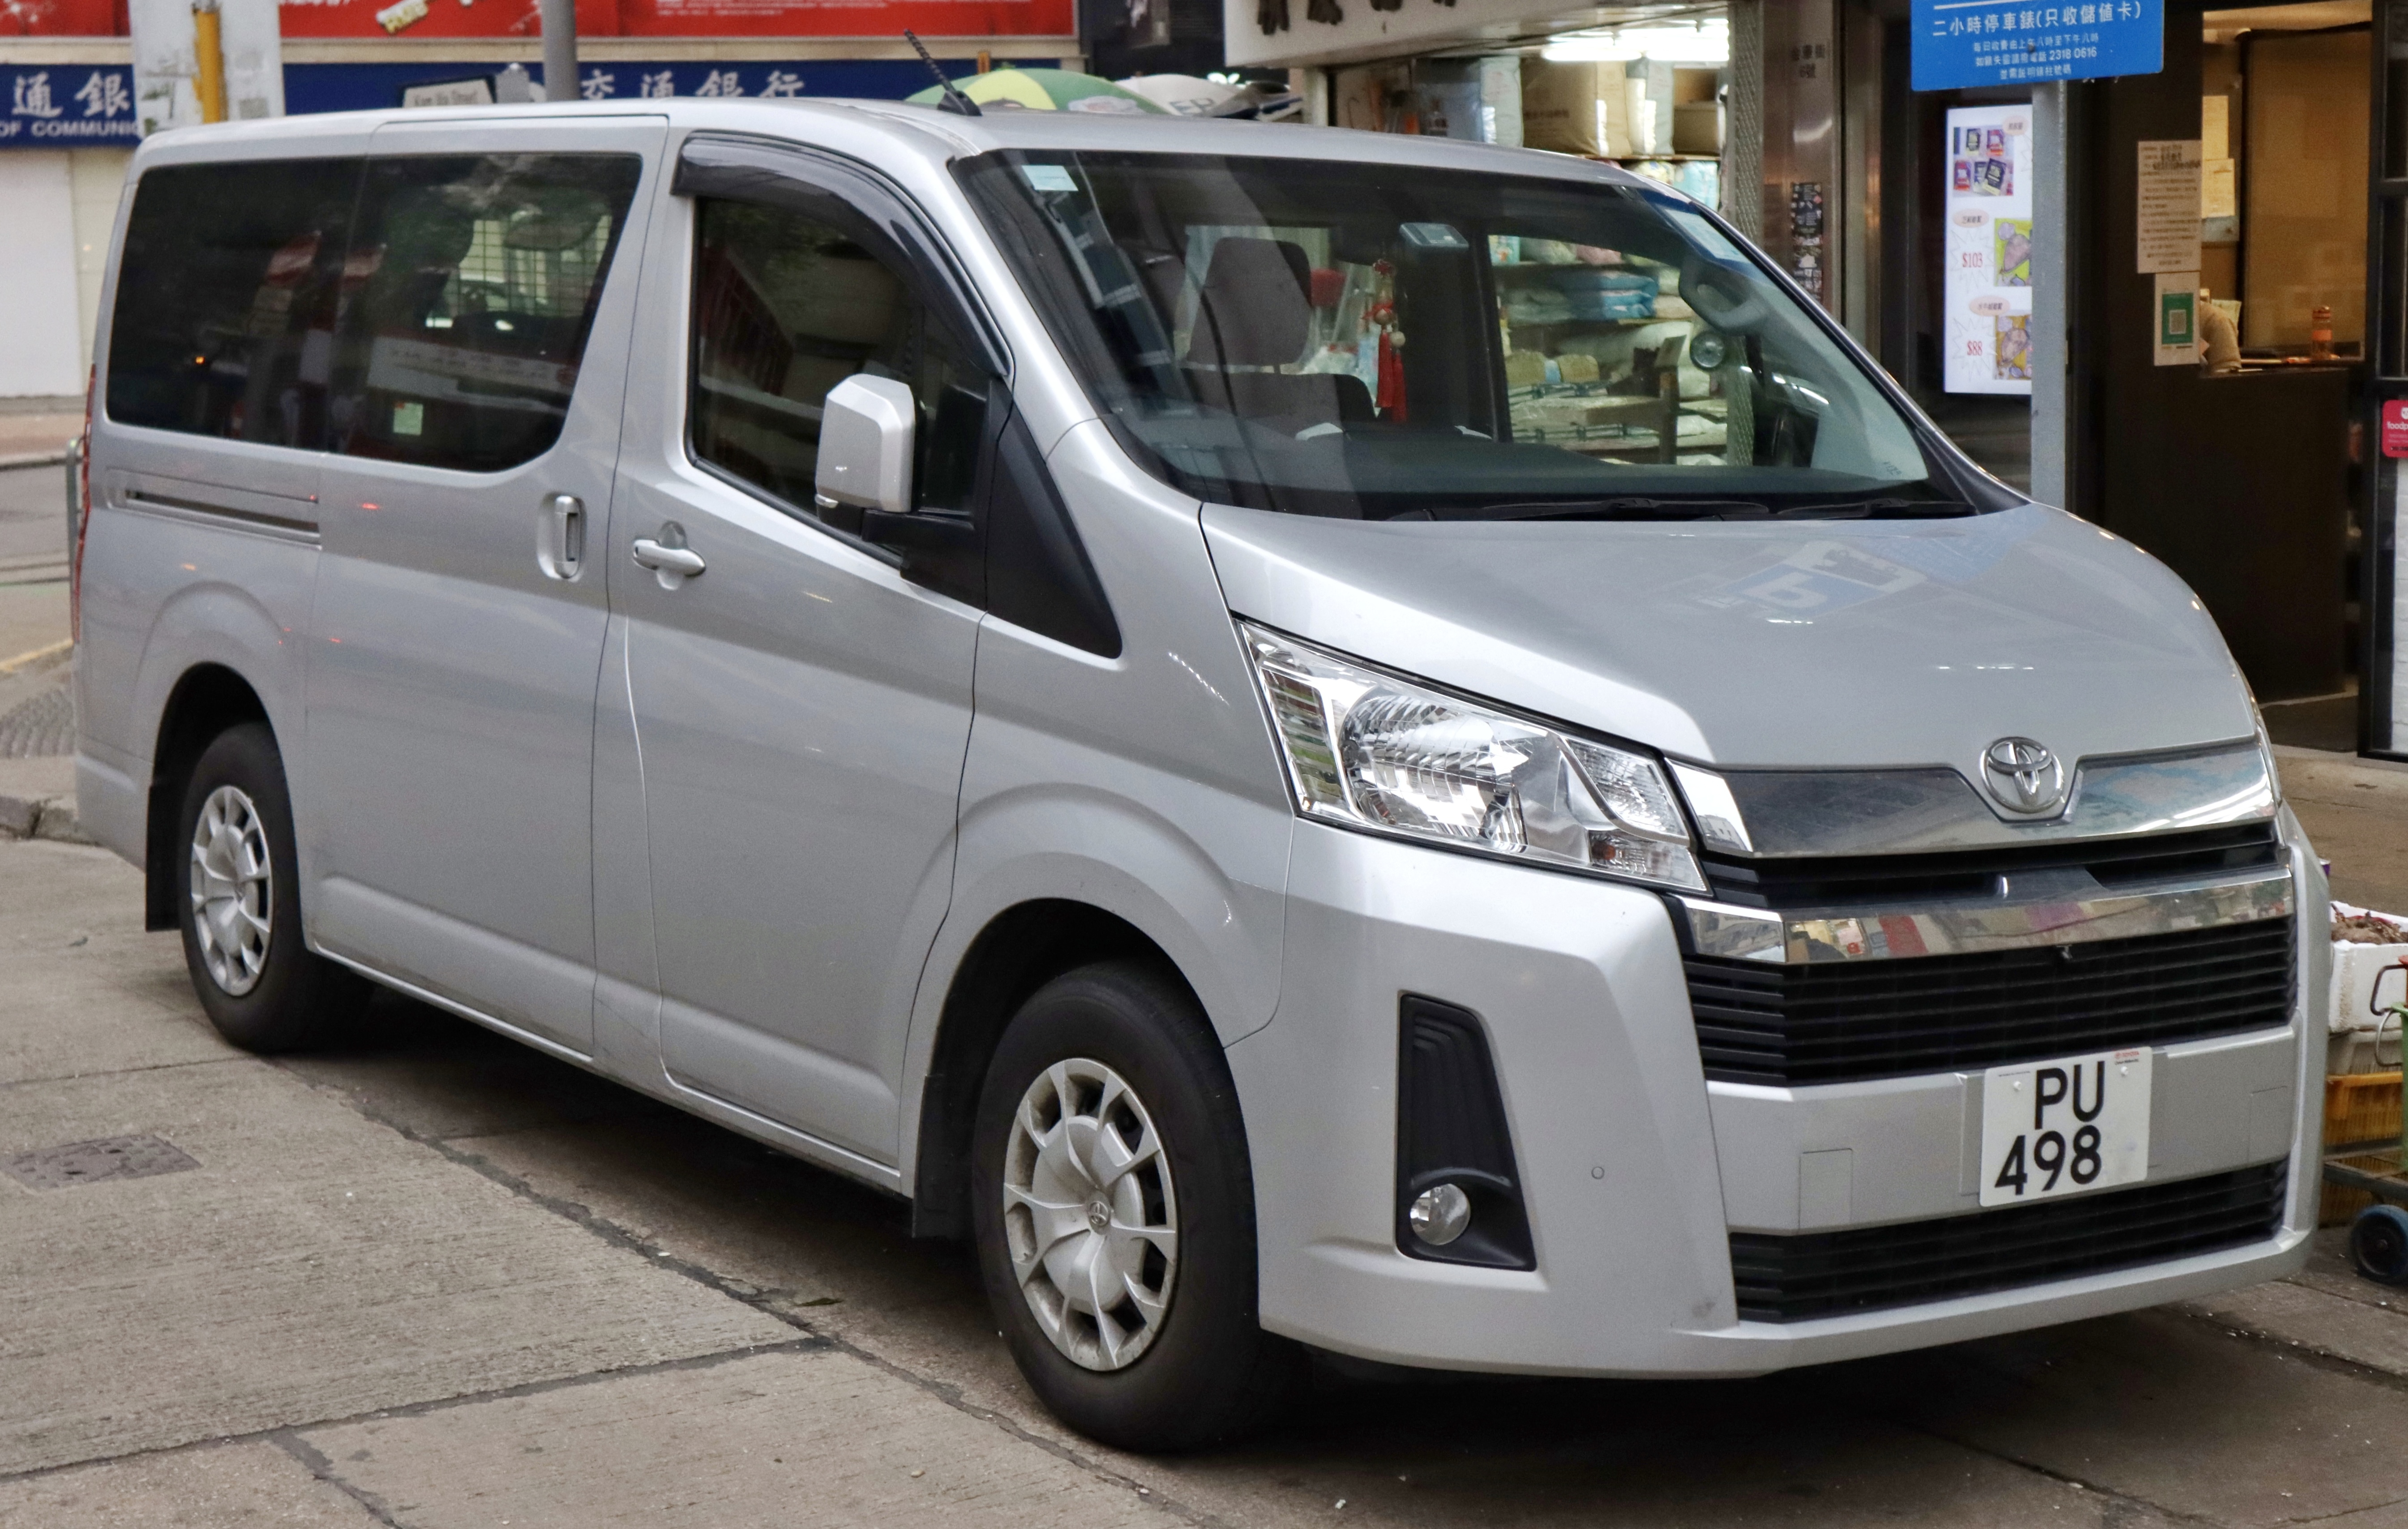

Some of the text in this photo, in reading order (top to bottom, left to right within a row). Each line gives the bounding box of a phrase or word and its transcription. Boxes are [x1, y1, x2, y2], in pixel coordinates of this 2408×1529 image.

[2049, 48, 2072, 61] 2318
[2074, 46, 2097, 59] 0616
[581, 69, 804, 99] 交通銀行
[1962, 252, 1983, 268] $103
[1967, 340, 1983, 356] $88
[2034, 1060, 2105, 1130] PU
[1994, 1124, 2102, 1195] 498
